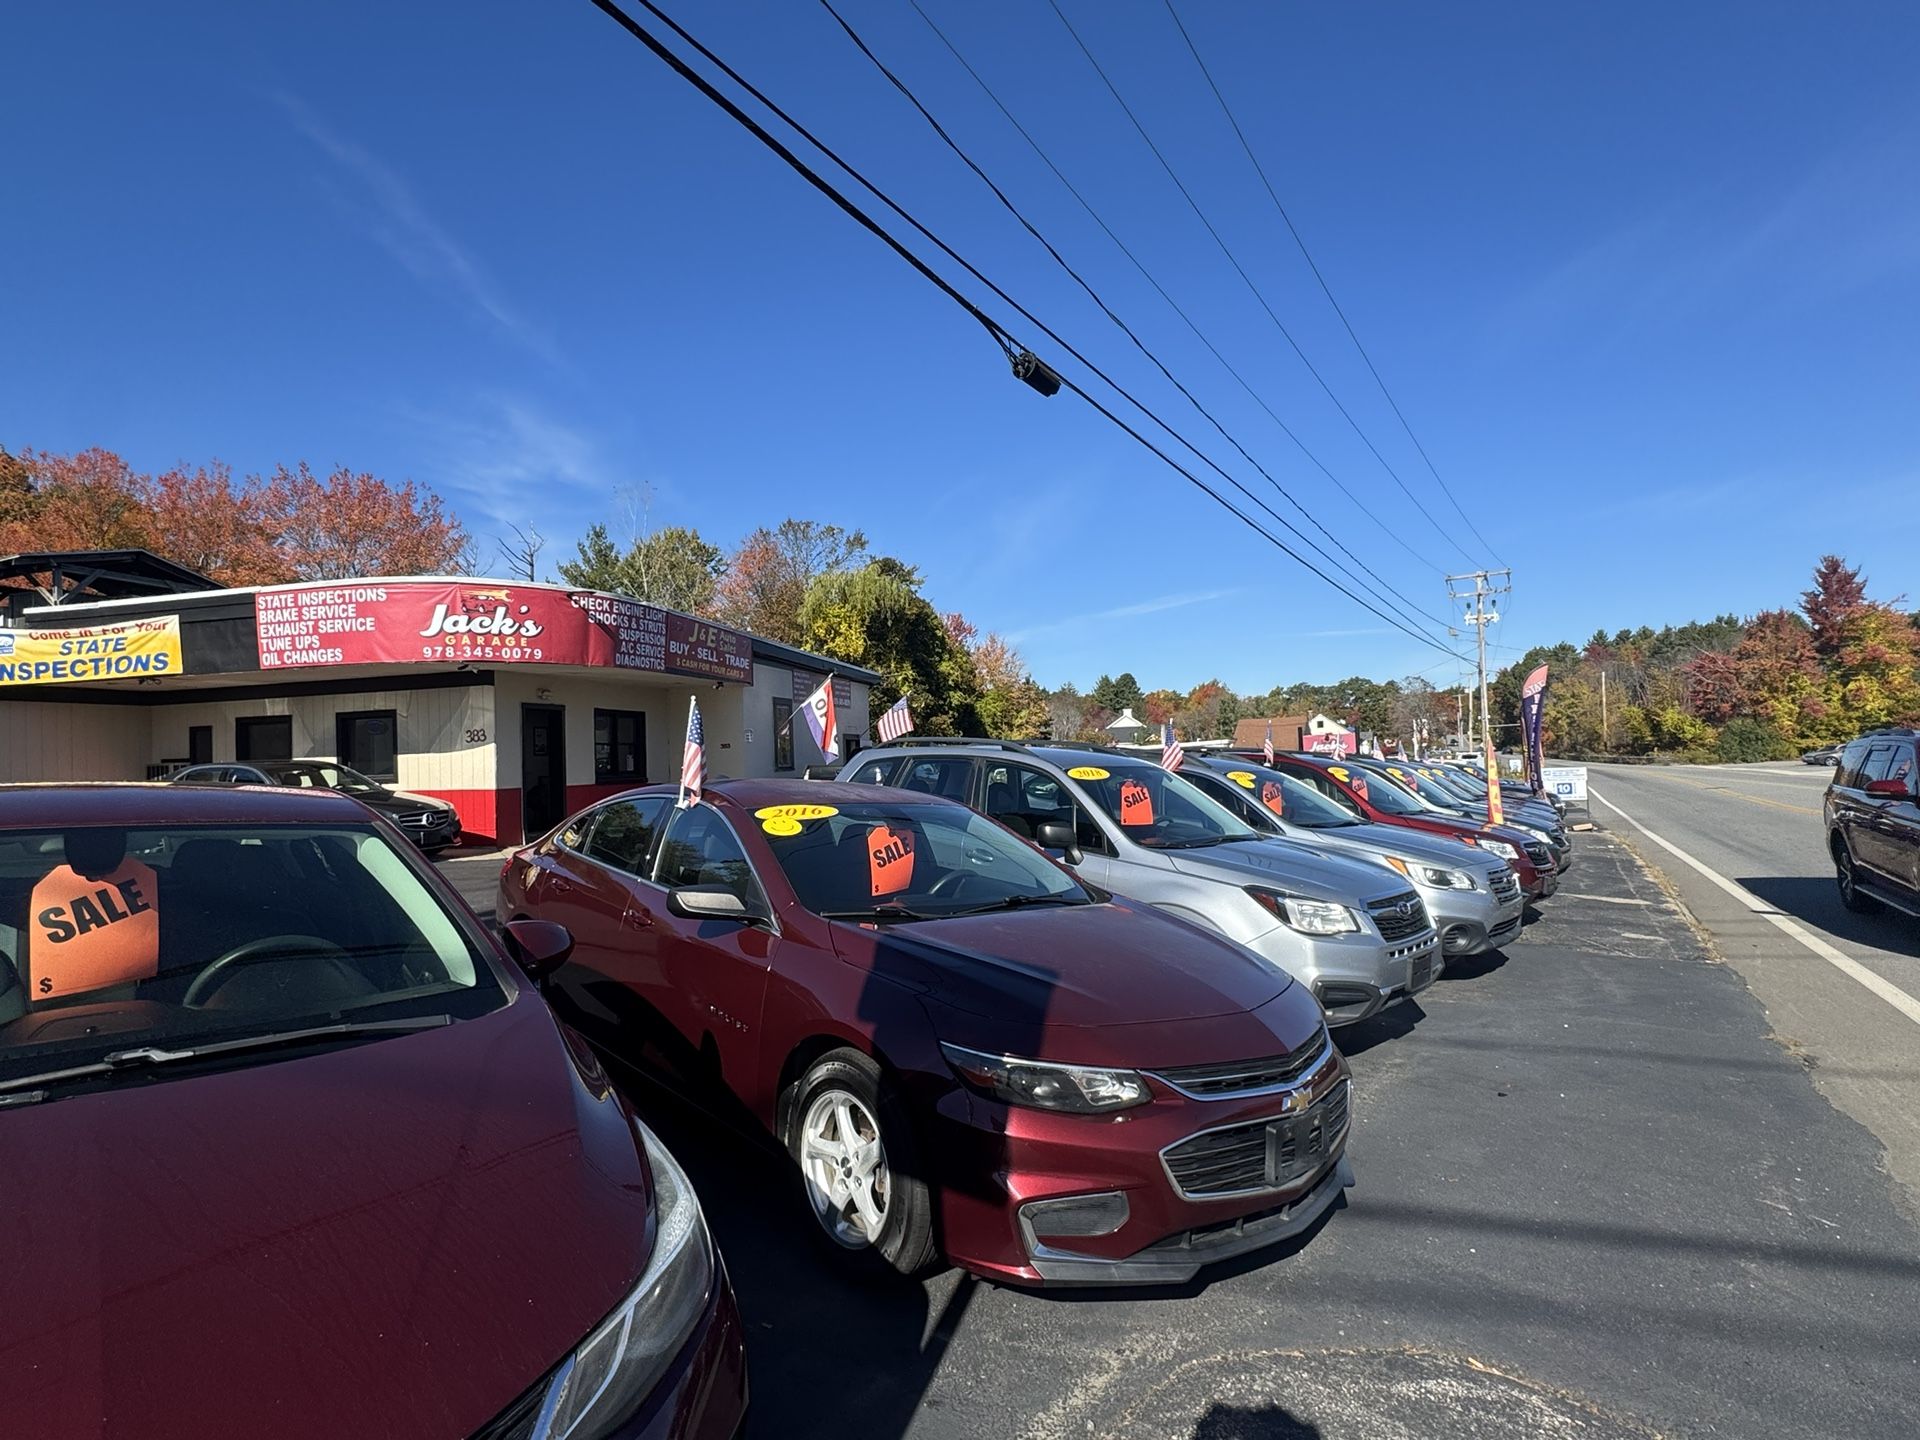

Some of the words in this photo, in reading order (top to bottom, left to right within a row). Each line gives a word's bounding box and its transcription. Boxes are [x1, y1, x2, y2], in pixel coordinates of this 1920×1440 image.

[257, 592, 294, 610] STATE
[298, 588, 387, 605] INSPECTIONS
[570, 596, 610, 612] CHECK
[613, 602, 645, 617] ENGINE
[646, 609, 666, 621] LIGHT
[259, 608, 298, 624] BRAKE
[301, 604, 356, 621] SERVICE
[420, 604, 543, 637] Jack's
[588, 611, 629, 627] SHOCKS
[631, 618, 637, 629] &
[639, 619, 666, 634] STRUTS
[29, 629, 71, 641] Come
[135, 622, 168, 632] Your
[260, 620, 317, 638] EXHAUST
[319, 617, 375, 634] SERVICE
[618, 628, 666, 646] SUSPENSION
[689, 623, 699, 642] J
[700, 628, 707, 641] &
[707, 627, 717, 647] E
[59, 636, 128, 656] STATE
[261, 637, 293, 651] TUNE
[296, 635, 320, 649] UPS
[445, 635, 528, 647] GARAGE
[262, 652, 281, 666] OIL
[284, 649, 343, 665] CHANGES
[423, 646, 542, 660] 978-345-0079
[636, 645, 665, 658] SERVICE
[670, 641, 689, 655] BUY
[697, 648, 718, 662] SELL
[725, 654, 750, 670] TRADE
[0, 652, 170, 681] NSPECTIONS
[615, 653, 665, 671] DIAGNOSTICS
[465, 729, 487, 744] 383
[1123, 789, 1148, 808] SALE
[1264, 785, 1281, 803] SALE
[772, 808, 823, 819] 2016
[873, 837, 912, 868] SALE
[874, 885, 879, 893] $
[38, 879, 150, 944] SALE
[40, 977, 53, 994] $
